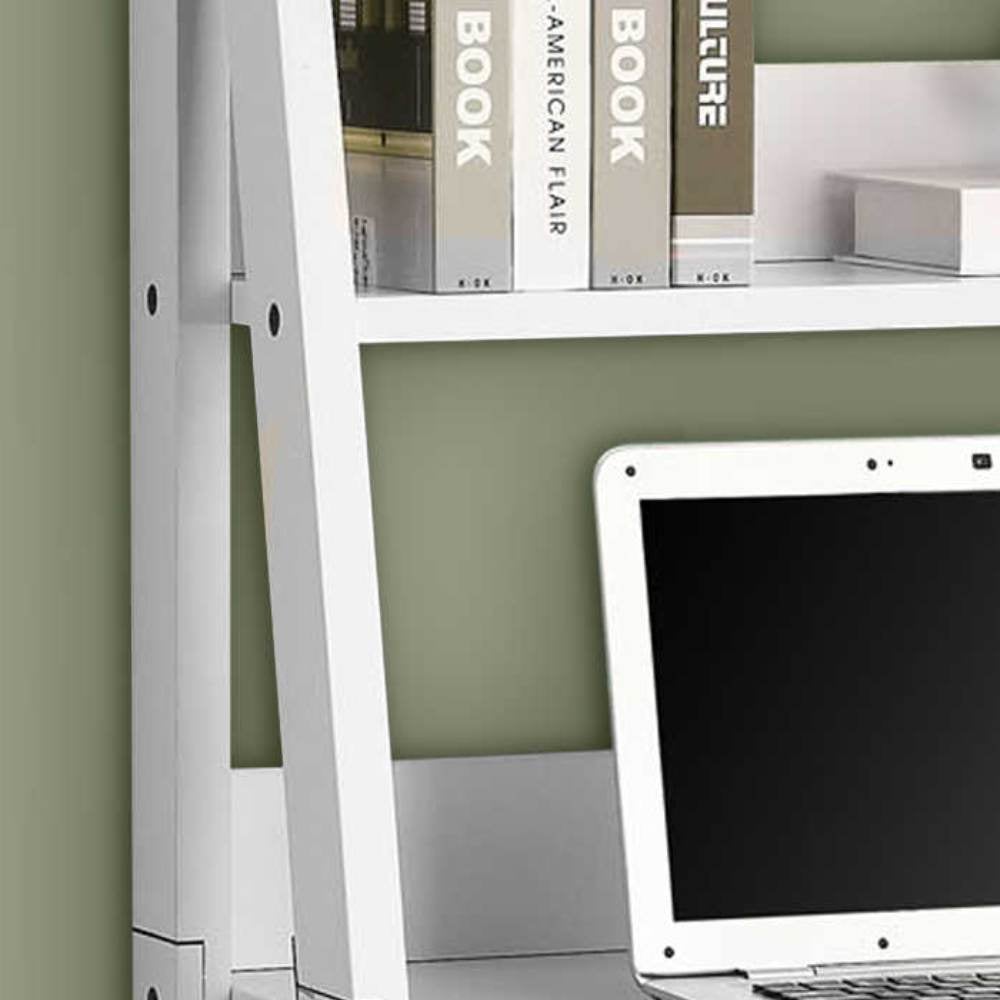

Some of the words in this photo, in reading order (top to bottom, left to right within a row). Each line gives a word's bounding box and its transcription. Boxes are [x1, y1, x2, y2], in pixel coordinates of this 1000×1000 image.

[456, 10, 492, 167] BOOK
[546, 0, 567, 153] -AMERICAN
[610, 8, 646, 164] BOOK
[549, 166, 567, 236] FLAIR
